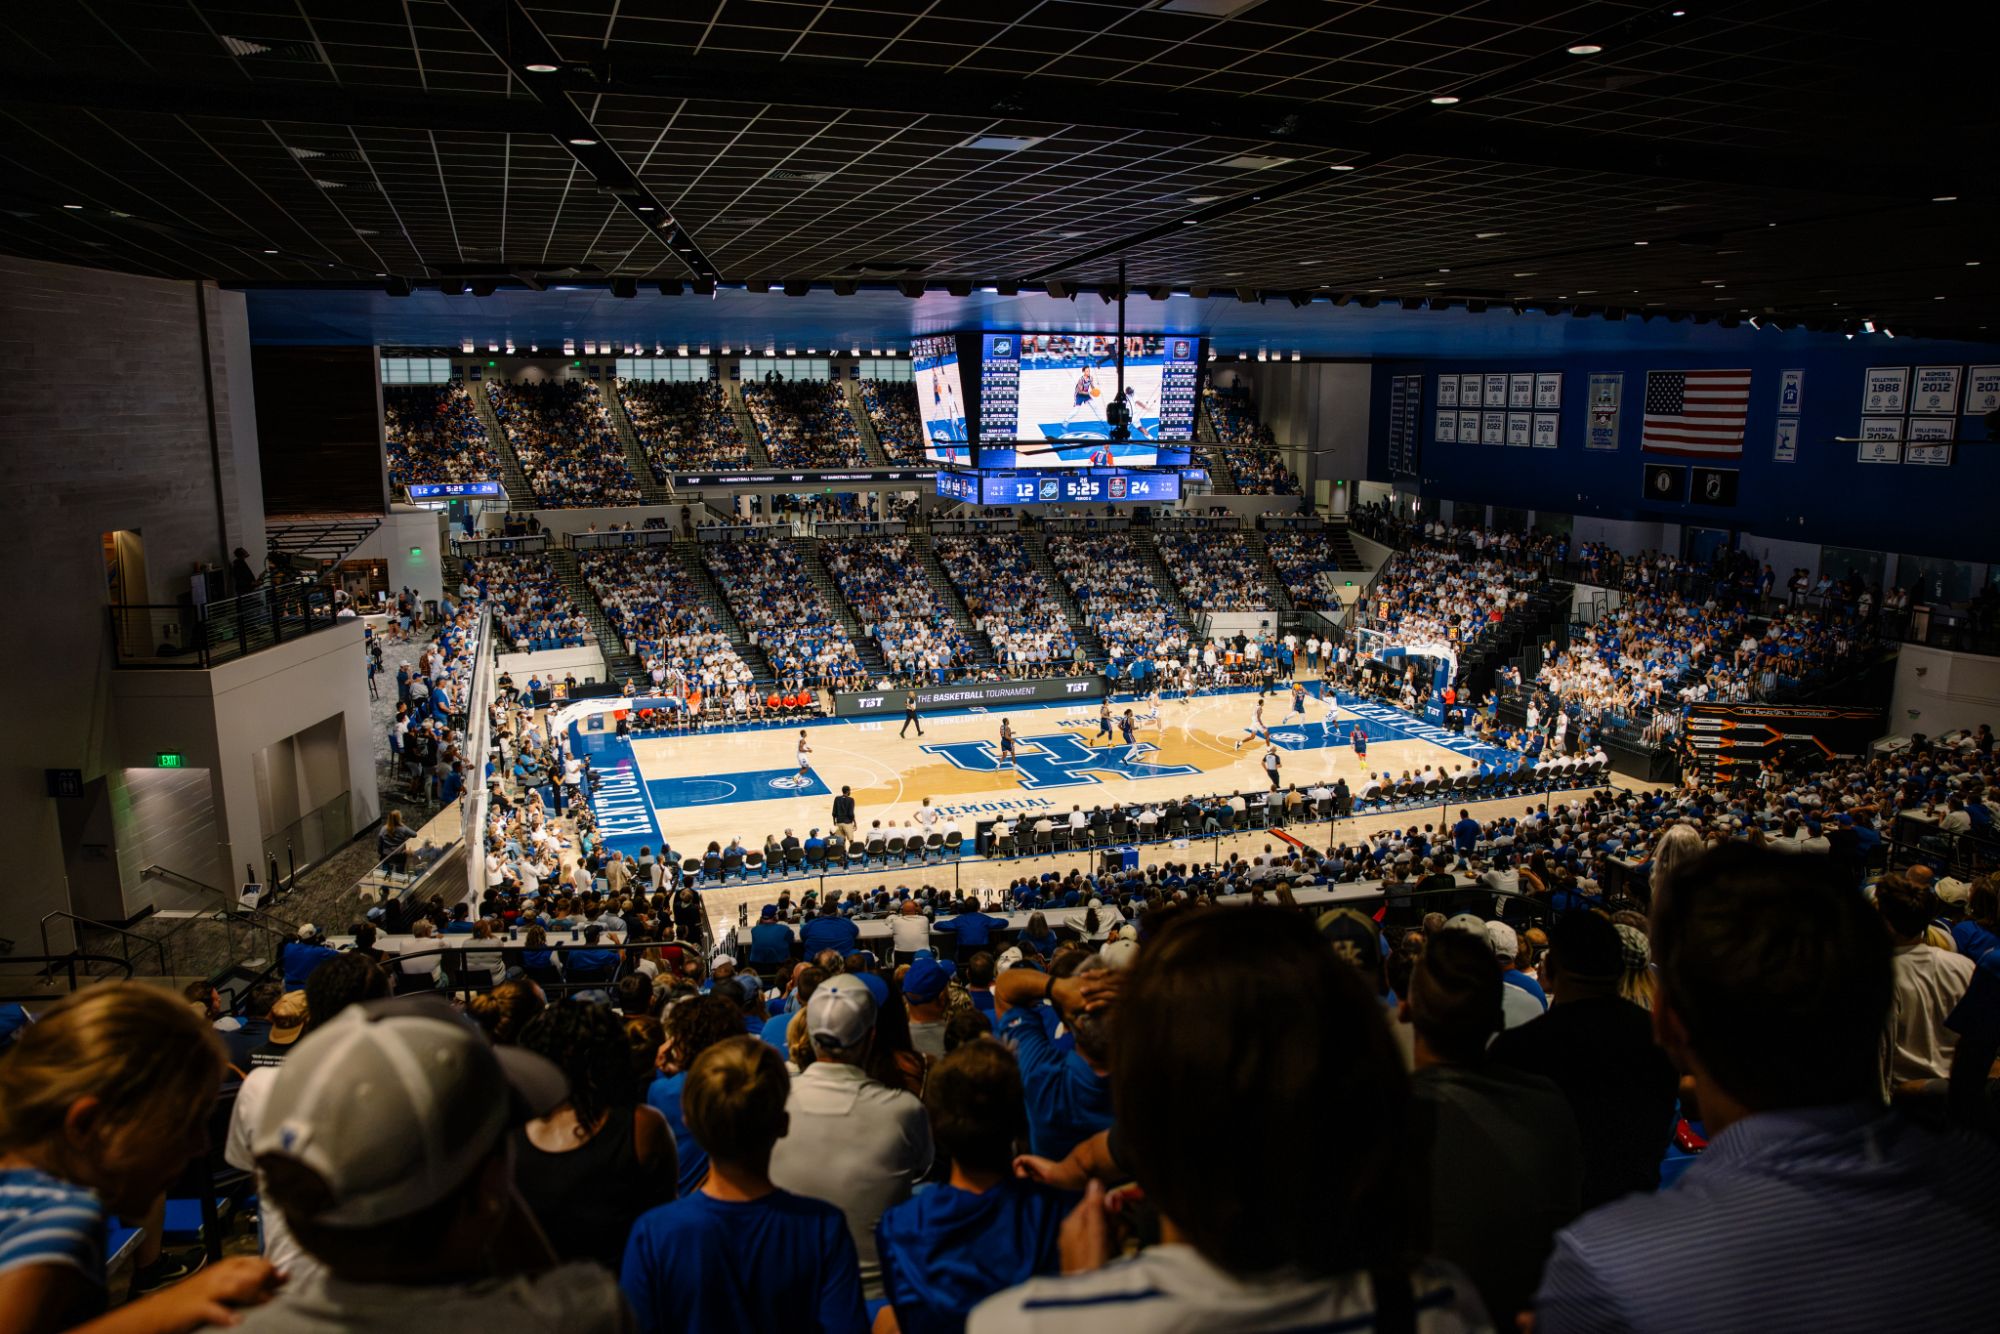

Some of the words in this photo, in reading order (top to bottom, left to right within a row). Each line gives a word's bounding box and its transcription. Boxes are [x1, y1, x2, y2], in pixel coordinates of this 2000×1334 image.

[1872, 384, 1900, 392] 1988
[1922, 383, 1951, 392] 2012
[1977, 383, 2000, 392] 201
[1512, 423, 1527, 431] 2022
[1016, 484, 1034, 497] 12
[1067, 482, 1100, 496] 5:25
[1131, 481, 1149, 494] 24
[917, 694, 932, 703] THE
[933, 690, 984, 702] BASKETBALL
[985, 686, 1036, 699] TOURNAMENT
[1340, 702, 1497, 751] KENTUCKY
[161, 754, 178, 767] EXIT
[590, 766, 653, 838] KENTUCKY
